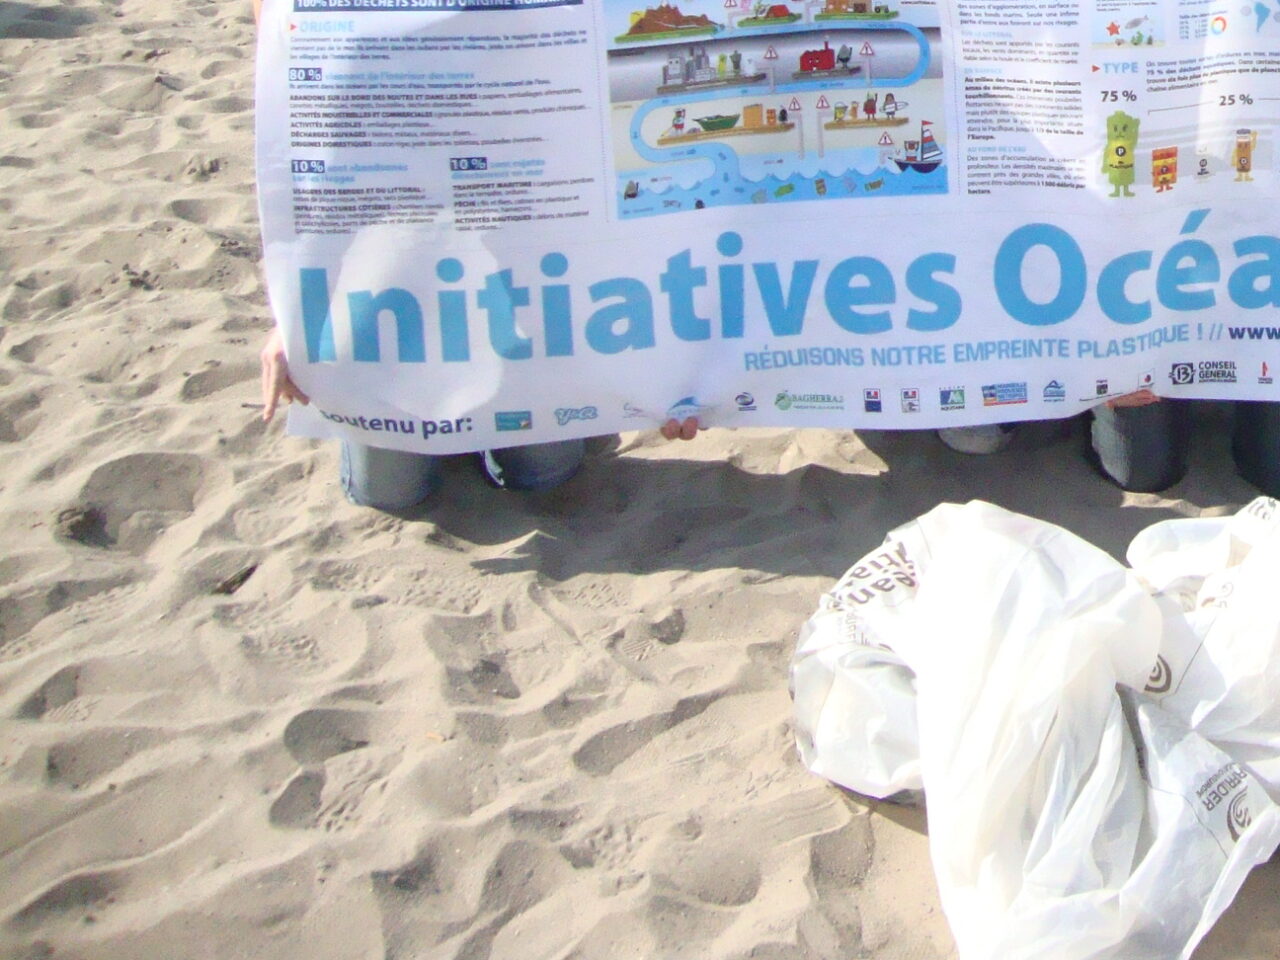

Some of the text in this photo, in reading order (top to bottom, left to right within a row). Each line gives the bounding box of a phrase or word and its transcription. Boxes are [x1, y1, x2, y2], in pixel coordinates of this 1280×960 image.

[300, 20, 355, 32] ORIGINE
[1103, 62, 1139, 74] TYPE
[290, 69, 322, 80] 80 %
[1100, 90, 1137, 103] 75 %
[1219, 94, 1254, 106] 25 %
[293, 161, 308, 171] 10
[310, 161, 324, 171] %
[452, 159, 467, 170] 10
[470, 158, 486, 170] %
[299, 231, 964, 363] Initiatives
[745, 344, 866, 372] RÉDUISONS
[871, 345, 948, 367] NOTRE
[953, 338, 1070, 365] EMPREINTE
[1077, 323, 1191, 359] PLASTIQUE
[1198, 360, 1237, 370] CONSEIL
[423, 416, 474, 440] par:
